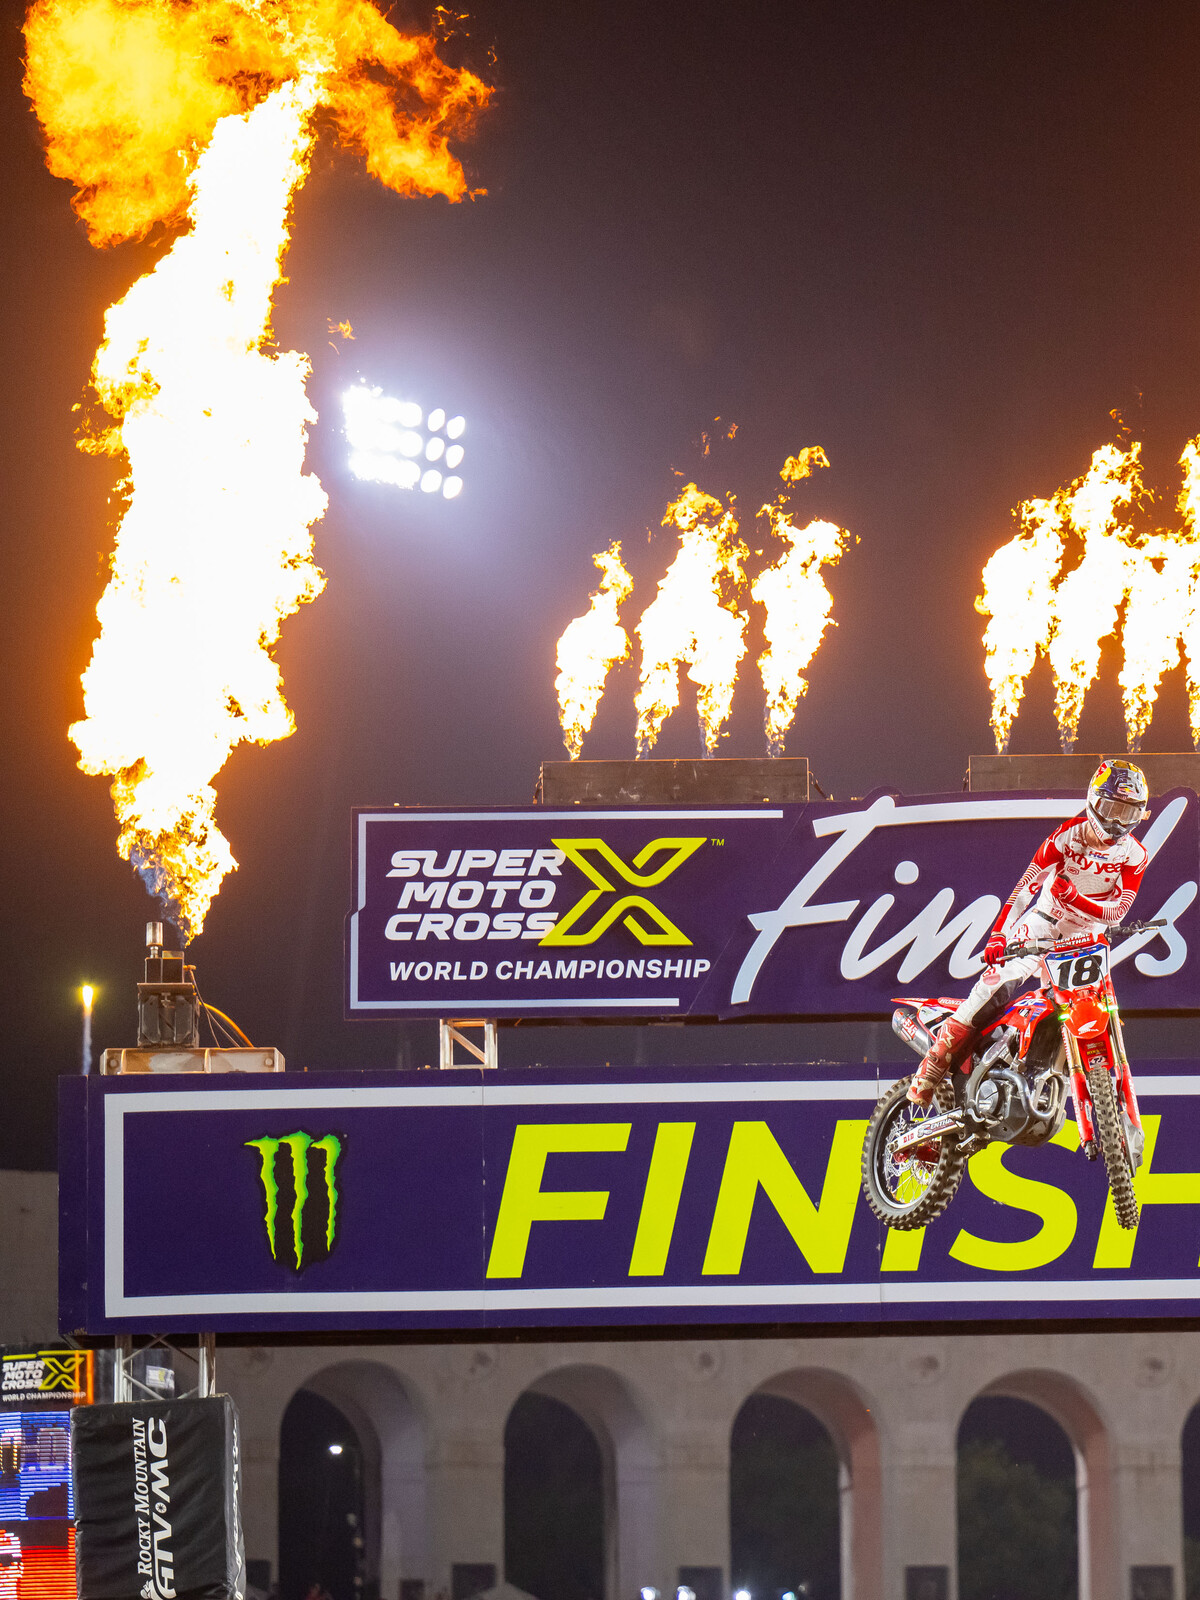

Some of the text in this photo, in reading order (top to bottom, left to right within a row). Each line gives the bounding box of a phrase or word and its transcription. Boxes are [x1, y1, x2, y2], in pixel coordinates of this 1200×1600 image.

[385, 849, 568, 879] SUPER
[397, 880, 558, 909] MOTO
[732, 794, 1198, 1004] Finls
[384, 912, 560, 941] CROSS
[389, 958, 711, 982] WORLD CHAMPIONSHIP
[1056, 955, 1102, 991] 18
[2, 1360, 46, 1372] SUPER
[4, 1369, 44, 1381] MOTO
[1, 1379, 44, 1390] CROSS
[2, 1391, 87, 1402] WORLD CHAMPIONSHIP
[132, 1417, 153, 1577] ROCKY MOUNTAIN
